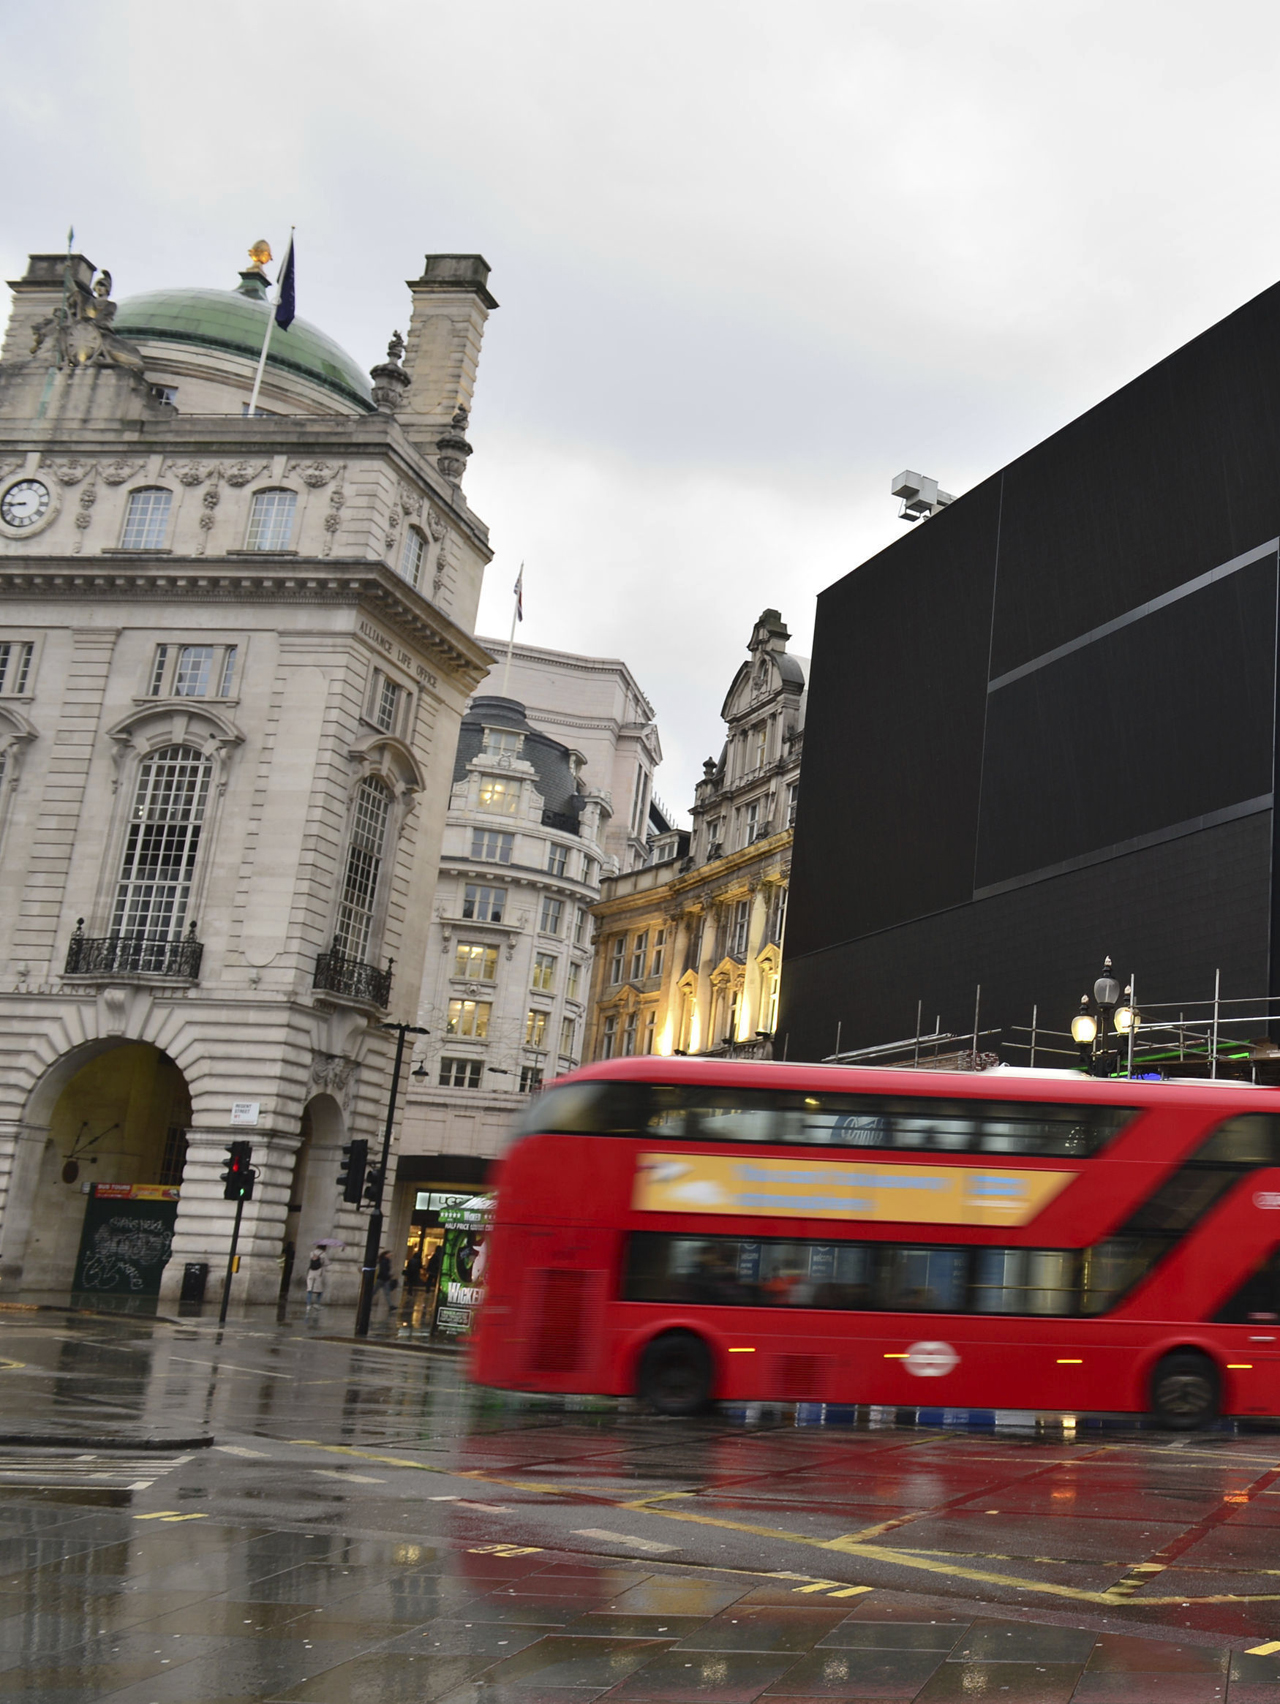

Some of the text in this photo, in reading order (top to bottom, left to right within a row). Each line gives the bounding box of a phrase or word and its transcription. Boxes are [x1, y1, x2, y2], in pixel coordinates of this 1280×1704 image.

[359, 621, 438, 689] ALLIANCE LIFE OFFICE
[12, 983, 190, 998] ALLIANCE LIFE
[457, 1223, 470, 1231] PRICE
